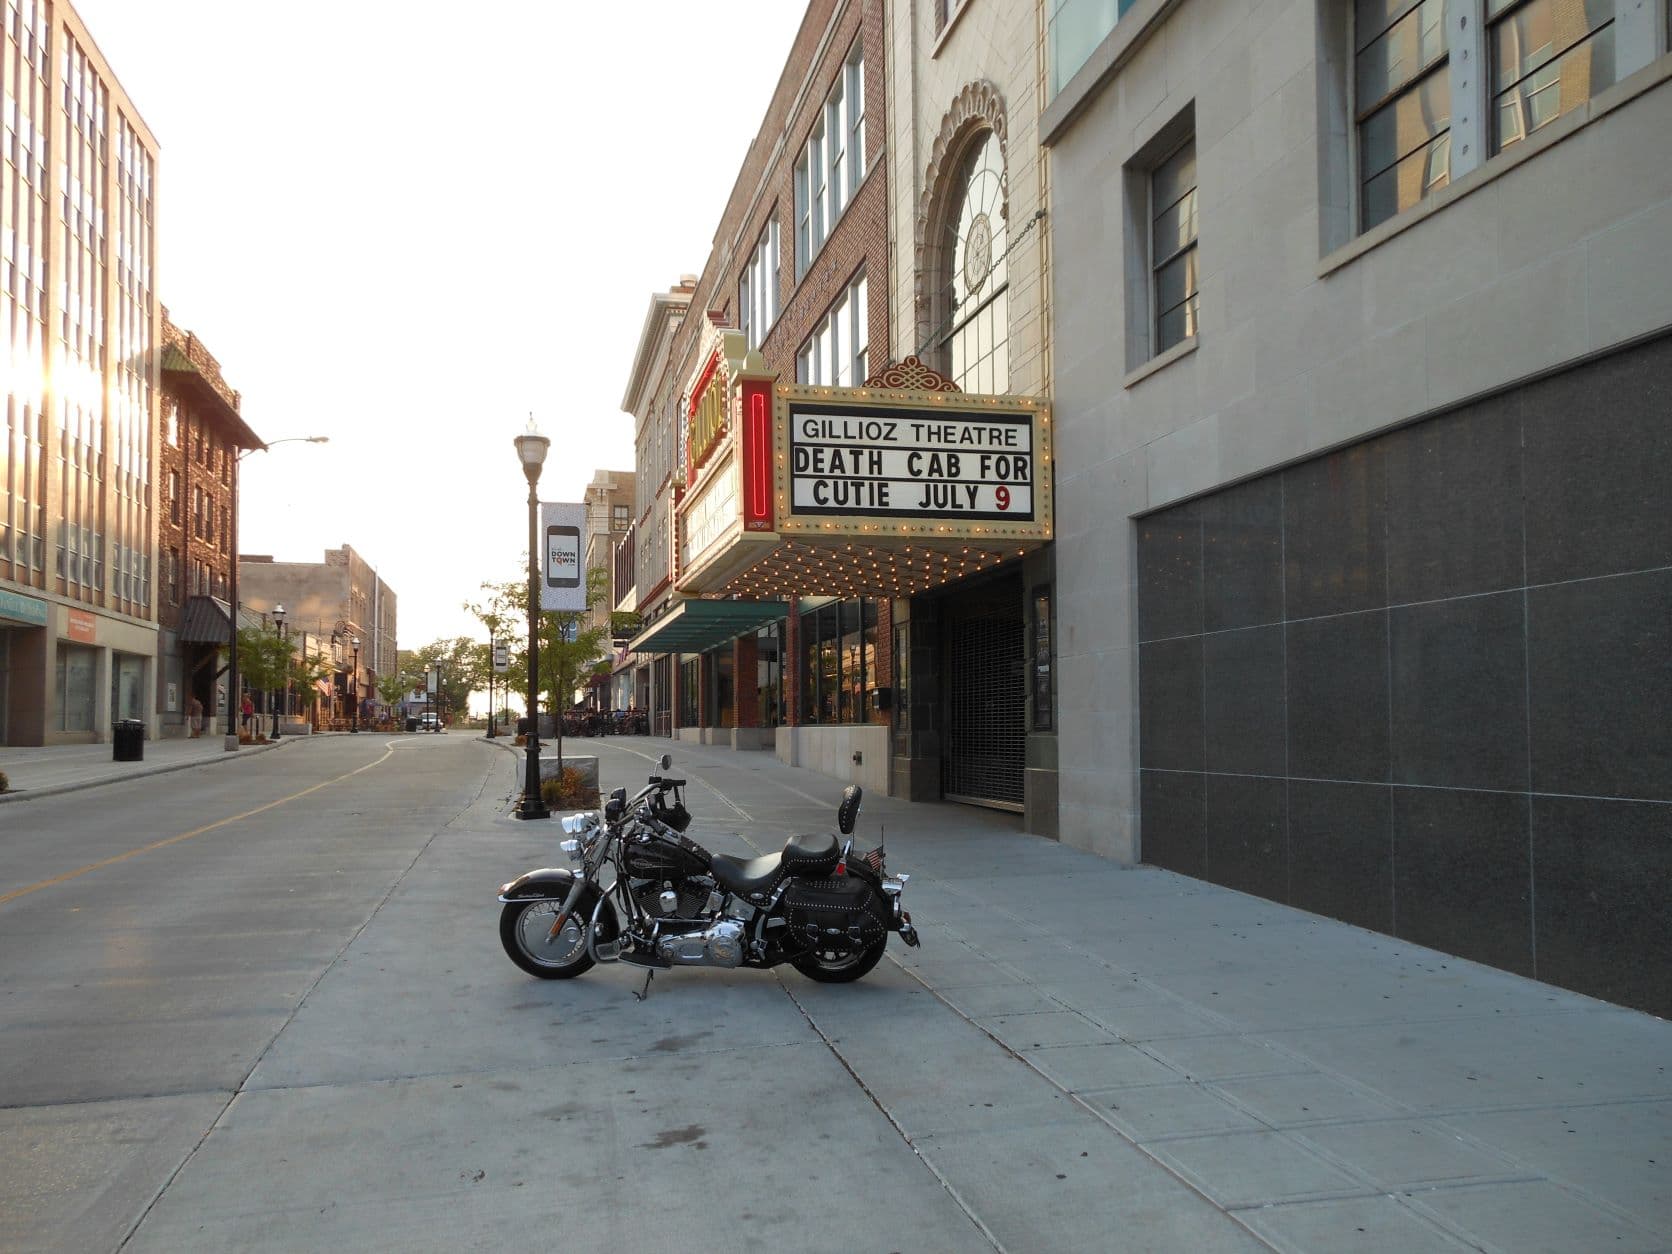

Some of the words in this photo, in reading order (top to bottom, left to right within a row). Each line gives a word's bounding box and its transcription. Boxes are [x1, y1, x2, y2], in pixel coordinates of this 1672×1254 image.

[802, 419, 898, 441] GILLIOZ
[910, 423, 1018, 447] THEATRE
[794, 447, 883, 475] DEATH
[907, 451, 961, 478] CAB
[980, 454, 1028, 481] FOR
[812, 479, 890, 507] CUTIE
[918, 483, 979, 509] JULY
[995, 485, 1011, 510] 9
[551, 557, 576, 565] TOWN
